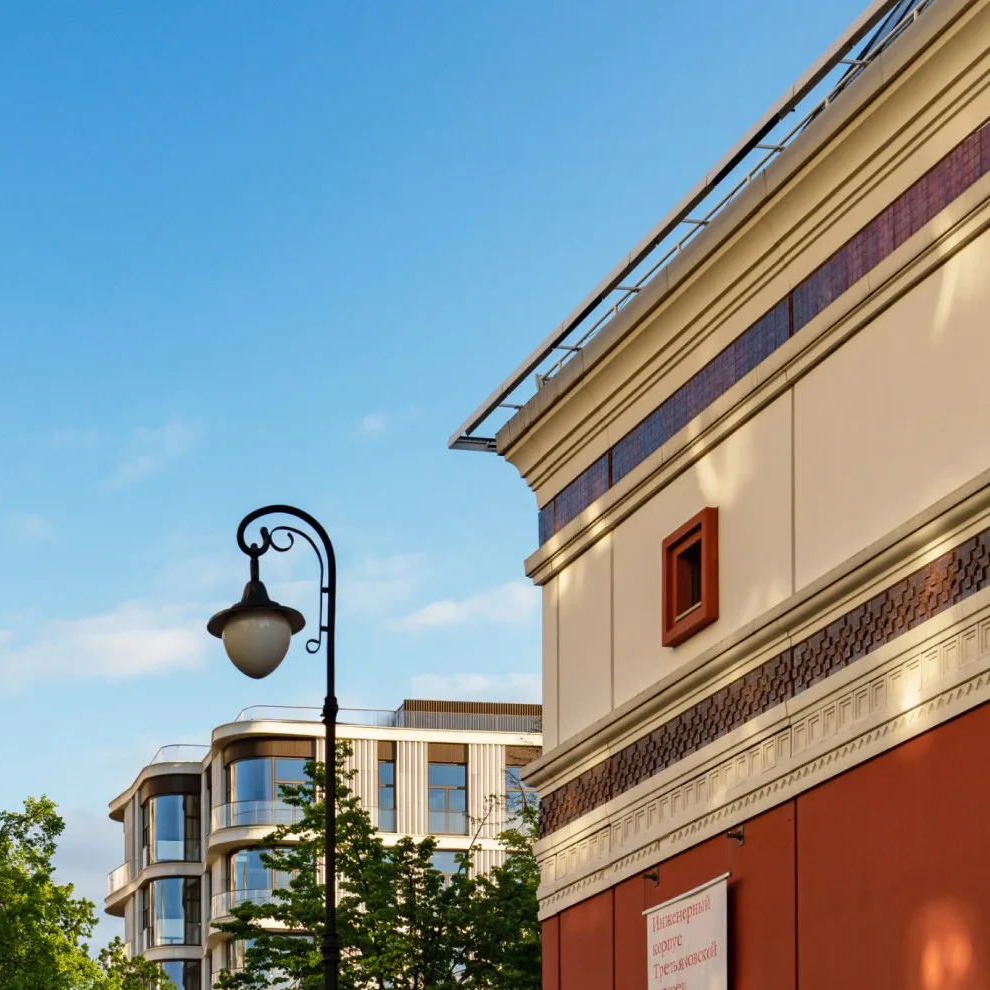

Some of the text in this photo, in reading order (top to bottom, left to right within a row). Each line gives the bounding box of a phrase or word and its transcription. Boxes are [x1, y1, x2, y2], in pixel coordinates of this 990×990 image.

[652, 894, 711, 932] Инженерный
[652, 934, 683, 958] корпус
[652, 941, 718, 983] Третьяковской
